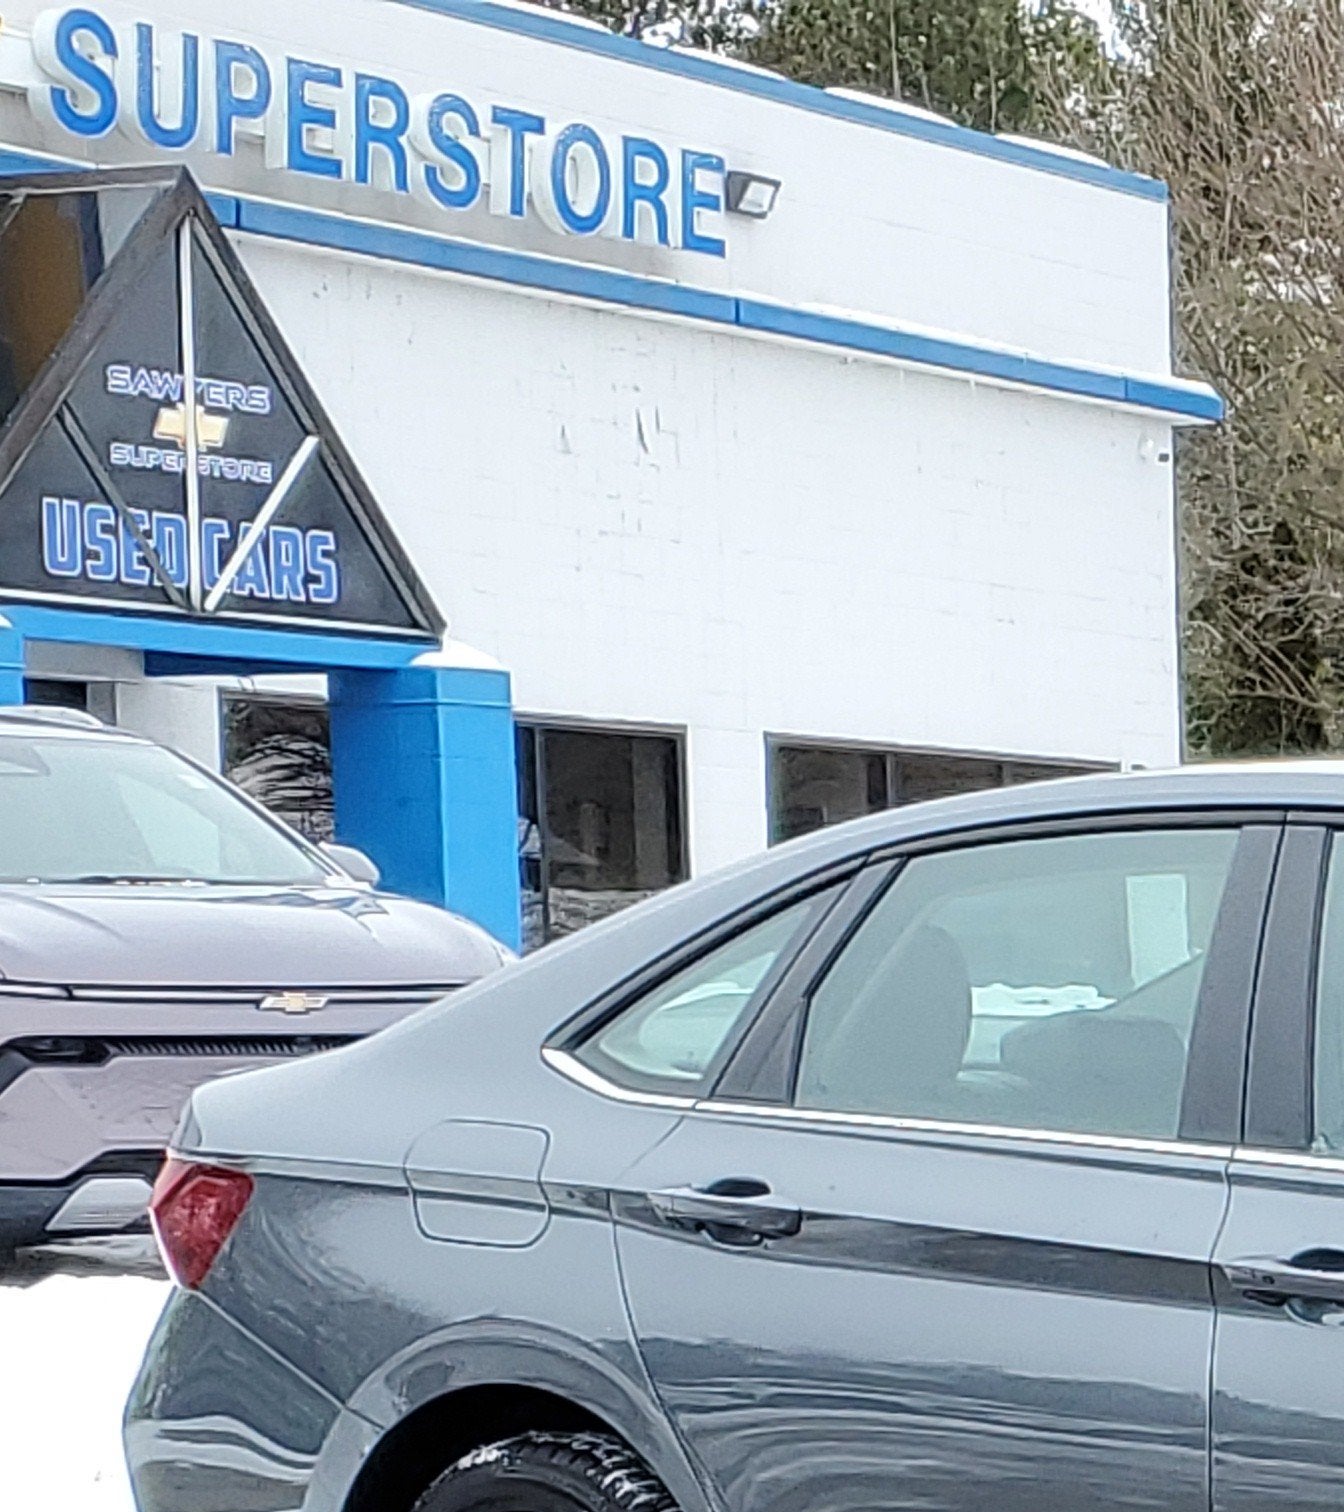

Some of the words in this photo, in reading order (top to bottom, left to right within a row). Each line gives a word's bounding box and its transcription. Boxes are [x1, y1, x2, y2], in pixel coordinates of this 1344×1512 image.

[50, 8, 727, 258] SUPERSTORE
[109, 441, 273, 484] SUPESTORE
[42, 497, 189, 588] USED
[201, 517, 339, 604] CARS
